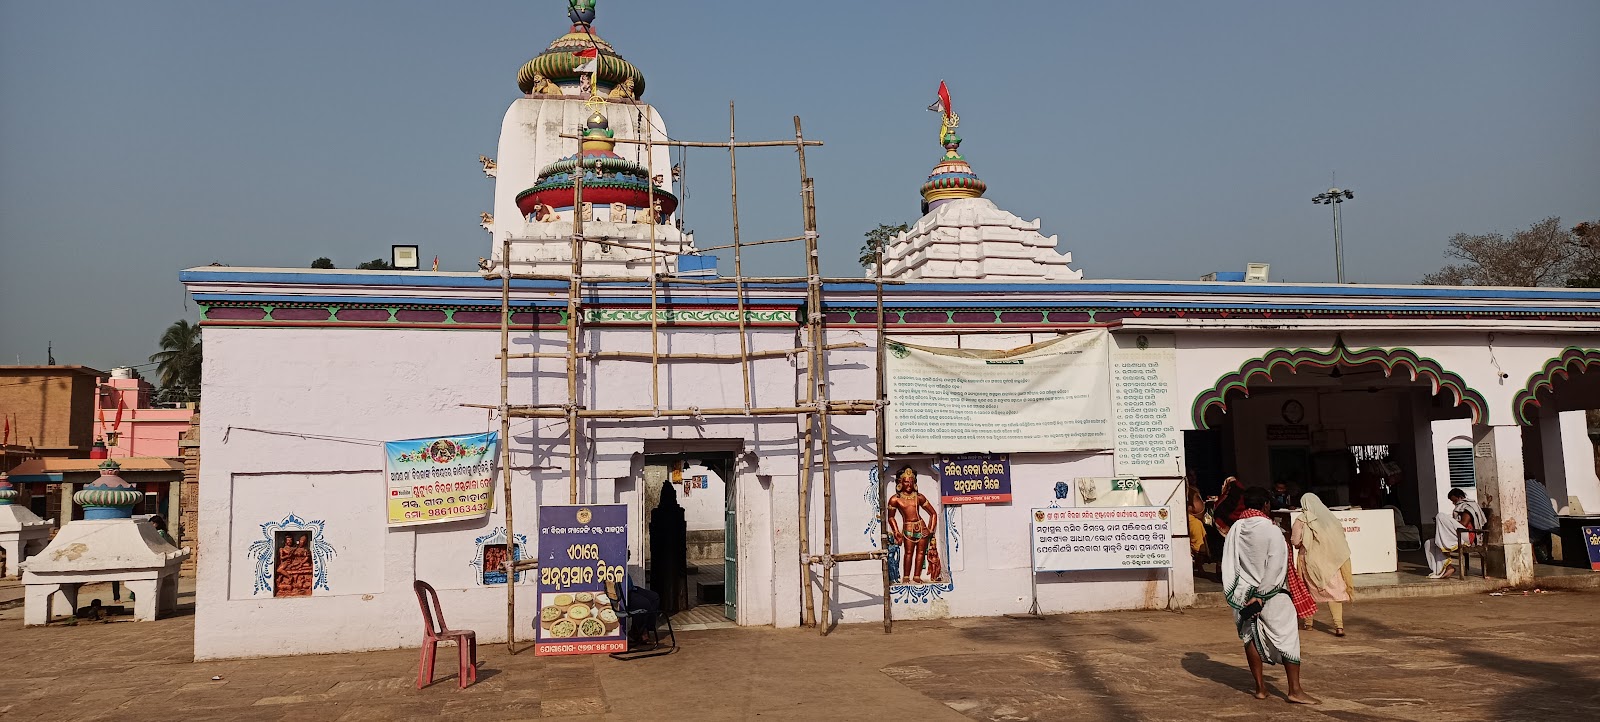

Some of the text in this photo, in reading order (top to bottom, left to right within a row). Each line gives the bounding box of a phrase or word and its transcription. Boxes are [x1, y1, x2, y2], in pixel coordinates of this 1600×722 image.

[945, 462, 962, 476] ମନ୍ଦିର
[982, 461, 1004, 475] ଭିତରେ
[435, 481, 453, 493] ବିରଜା
[984, 476, 1000, 490] ମିଳେ
[424, 498, 444, 506] ଗୀତ
[447, 496, 455, 504] ଓ
[429, 503, 488, 517] 9861063432
[1068, 511, 1080, 519] ବିରଜା
[1082, 511, 1093, 519] ମନ୍ଦିର
[551, 526, 567, 534] ବିରଜା
[1064, 524, 1081, 533] ରସିଦ
[1155, 522, 1168, 531] ପାଇଁ
[567, 543, 599, 561] ଏଠାରେ
[1036, 544, 1072, 554] ଯେକୌଣସି
[1074, 545, 1101, 553] ସରକାରୀ
[541, 560, 624, 591] ଅନ୍ନପ୍ରସାଦ ମିଳେ
